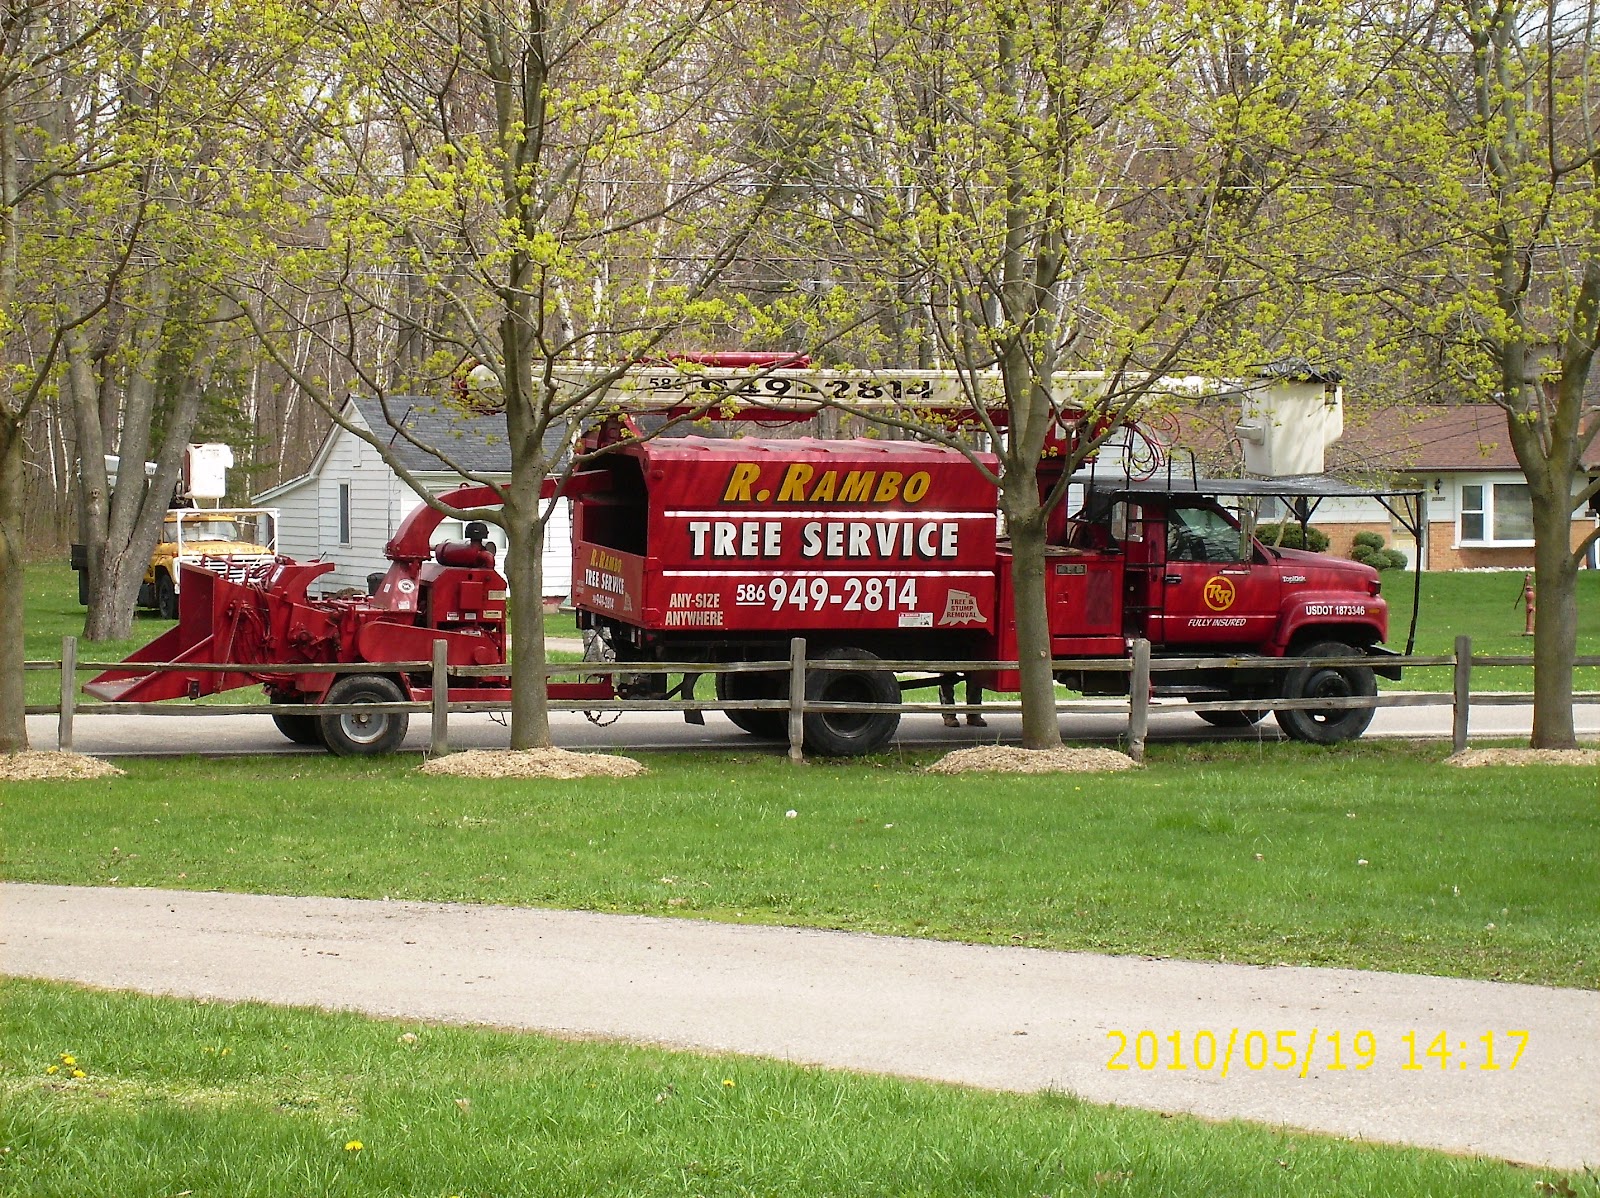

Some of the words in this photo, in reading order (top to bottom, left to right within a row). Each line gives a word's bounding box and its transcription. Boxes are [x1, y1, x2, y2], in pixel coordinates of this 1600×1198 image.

[689, 522, 782, 556] TREE
[803, 522, 959, 557] SERVICE
[585, 569, 599, 587] TREE
[601, 573, 624, 595] SERVICE
[669, 593, 720, 608] ANY-SIZE
[736, 584, 766, 602] 586
[768, 578, 918, 611] 949-2814
[665, 611, 724, 626] ANYWHERE
[1306, 606, 1333, 616] USDOT
[1335, 606, 1365, 616] 1873346
[1188, 618, 1212, 627] FULLY
[1212, 618, 1247, 627] INSURED
